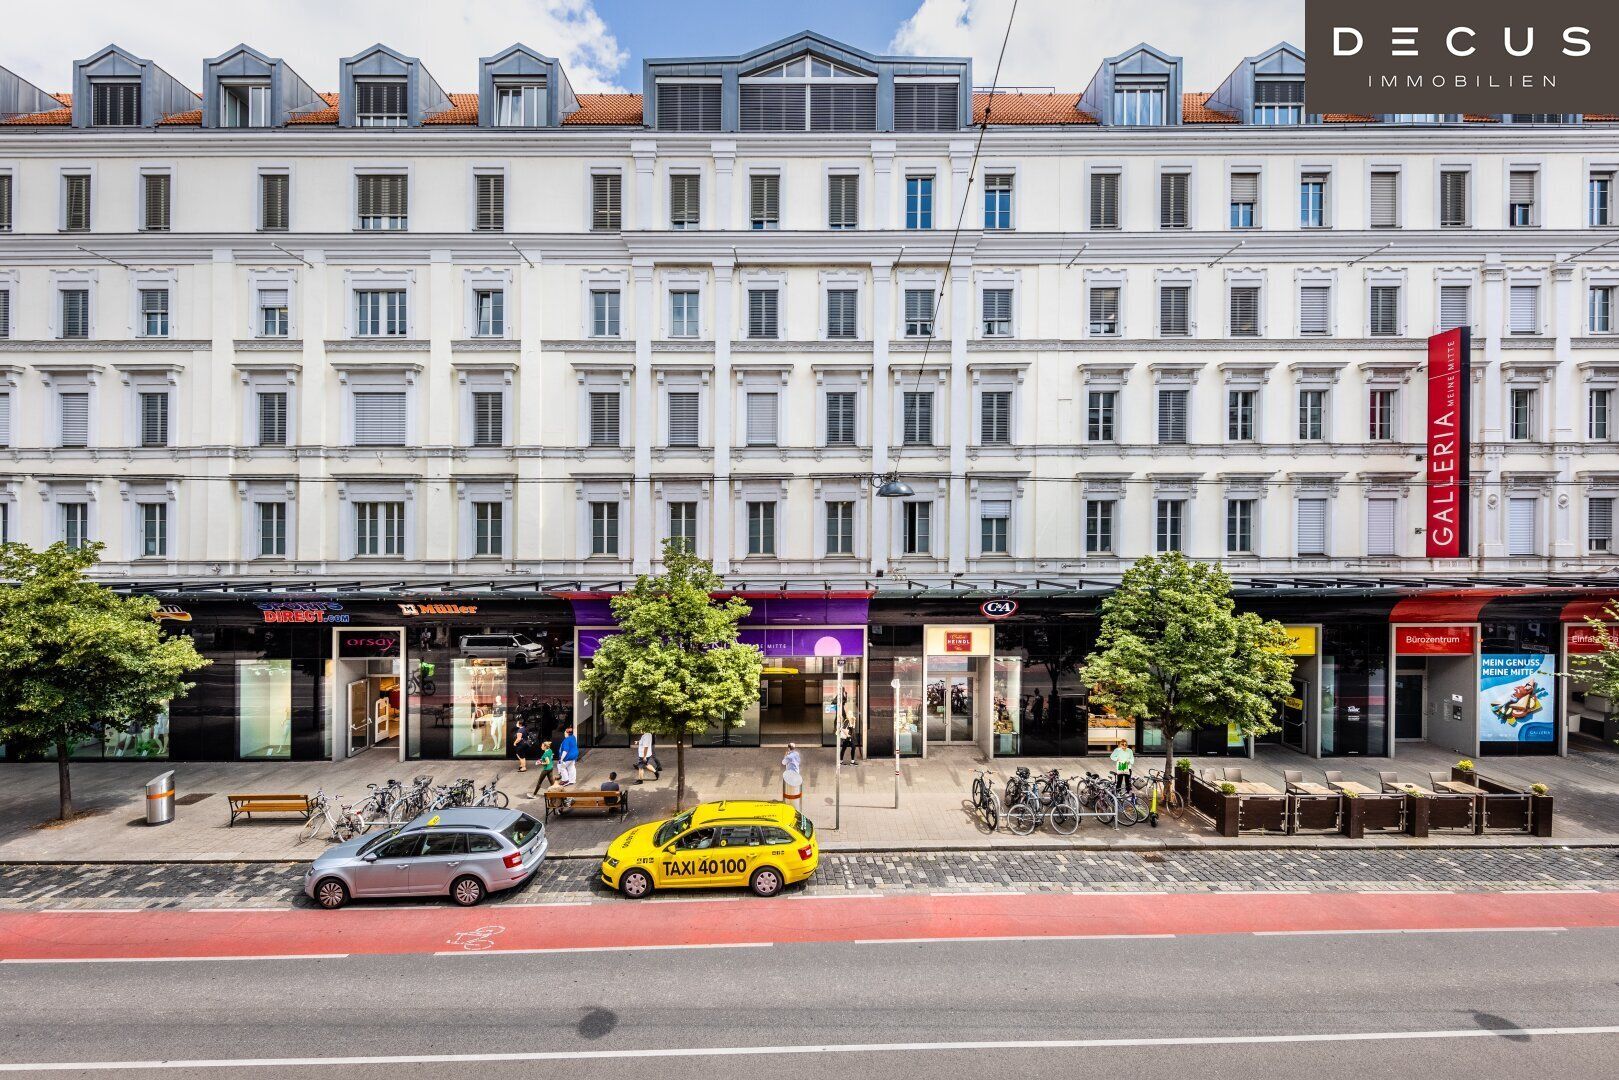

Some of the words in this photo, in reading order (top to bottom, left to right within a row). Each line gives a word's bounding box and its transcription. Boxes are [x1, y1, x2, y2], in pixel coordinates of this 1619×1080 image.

[1447, 340, 1455, 371] MITTE
[1447, 375, 1455, 407] MEINE
[1432, 410, 1454, 546] GALLERIA
[418, 604, 477, 614] Müller
[987, 602, 1011, 612] C&A
[346, 638, 396, 651] orsay
[1406, 635, 1460, 644] Bürozentrum
[1482, 658, 1504, 667] MEIN
[1505, 658, 1540, 667] GENUSS
[1482, 668, 1509, 676] MEINE
[1510, 668, 1534, 676] MITTE
[662, 860, 695, 876] TAXI
